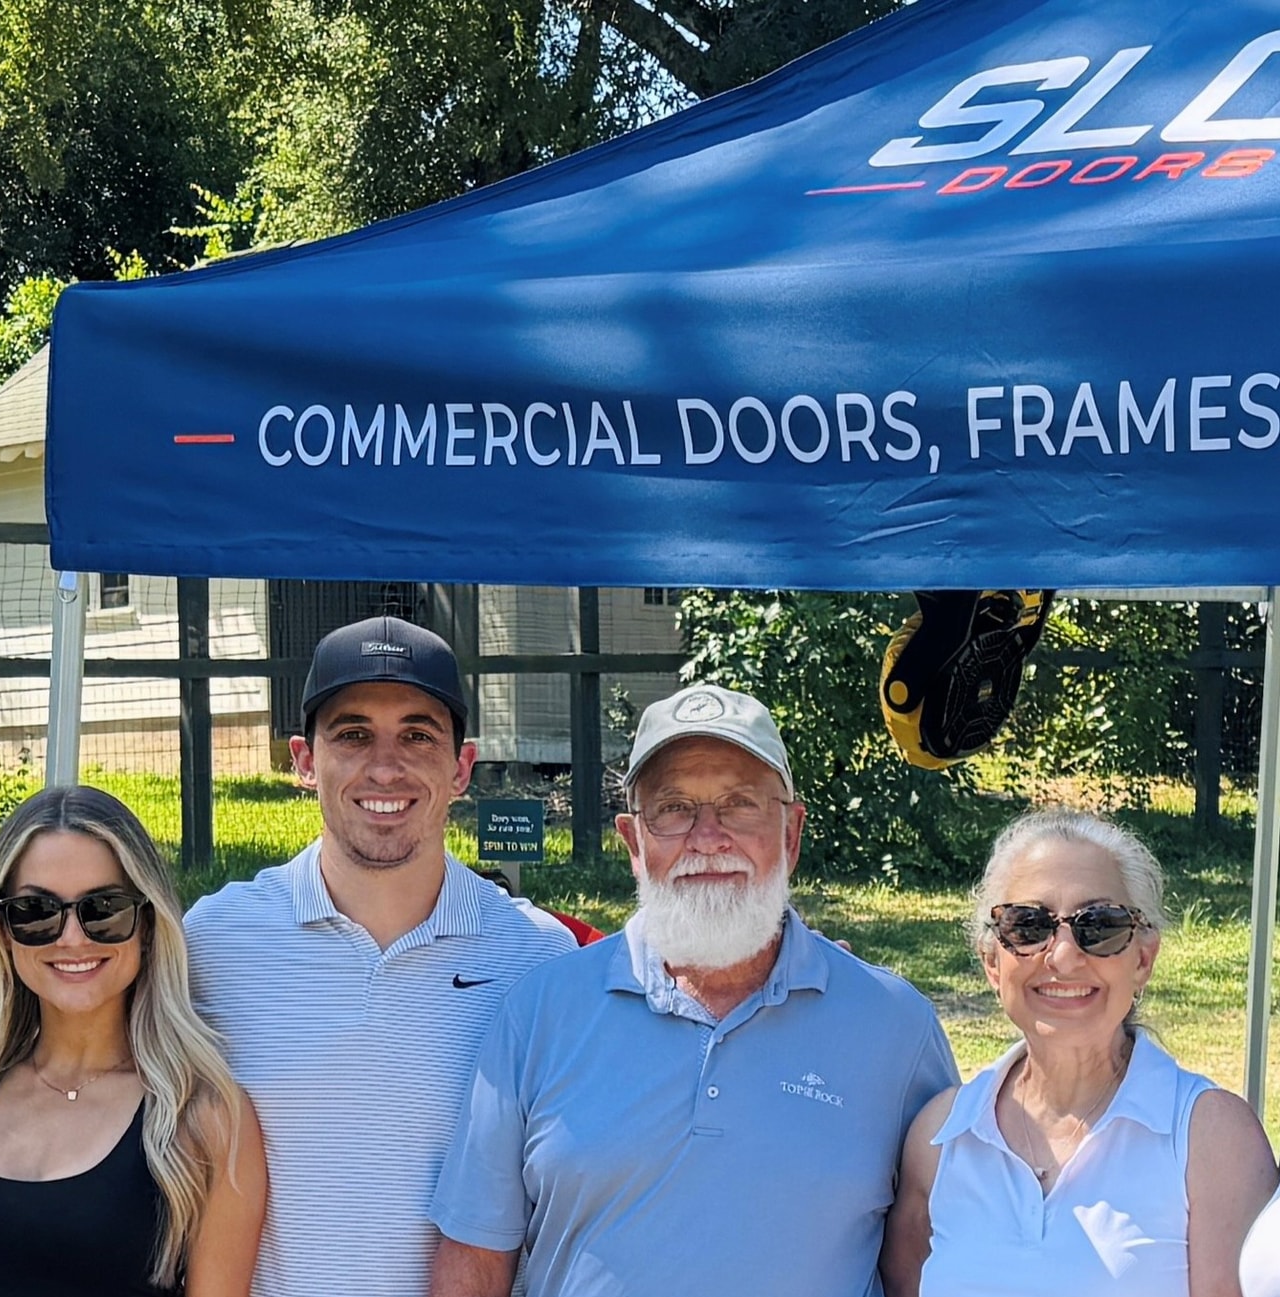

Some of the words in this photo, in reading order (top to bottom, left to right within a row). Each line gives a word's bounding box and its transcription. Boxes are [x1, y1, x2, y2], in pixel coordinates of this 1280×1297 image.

[937, 149, 1270, 195] DOORS
[258, 400, 662, 467] COMMERCIAL
[683, 391, 941, 473] DOORS,
[483, 841, 504, 851] SPIN
[505, 841, 518, 851] TO
[520, 841, 538, 852] WIN
